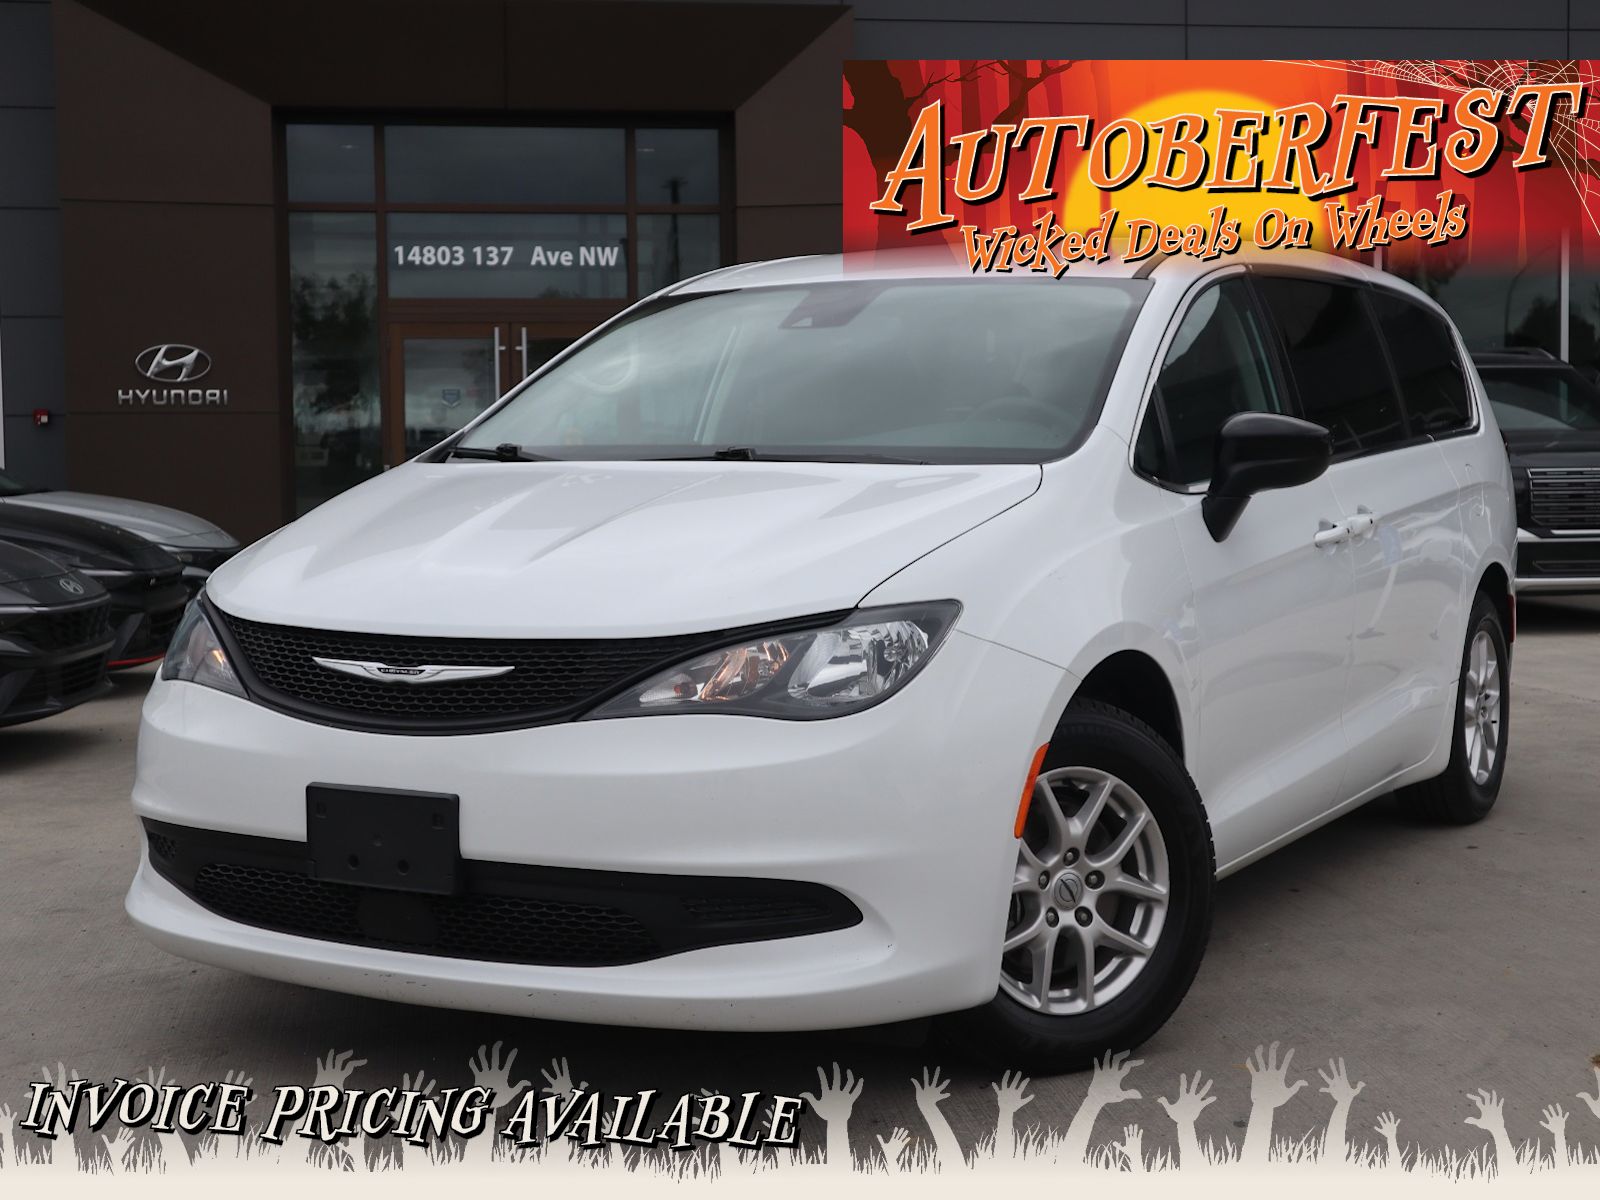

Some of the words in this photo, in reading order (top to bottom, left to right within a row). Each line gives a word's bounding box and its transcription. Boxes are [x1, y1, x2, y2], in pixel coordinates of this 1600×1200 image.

[394, 245, 465, 266] 14803
[472, 246, 514, 266] 137
[530, 246, 573, 267] Ave
[579, 246, 619, 266] NW
[117, 388, 228, 406] HYUNDAI
